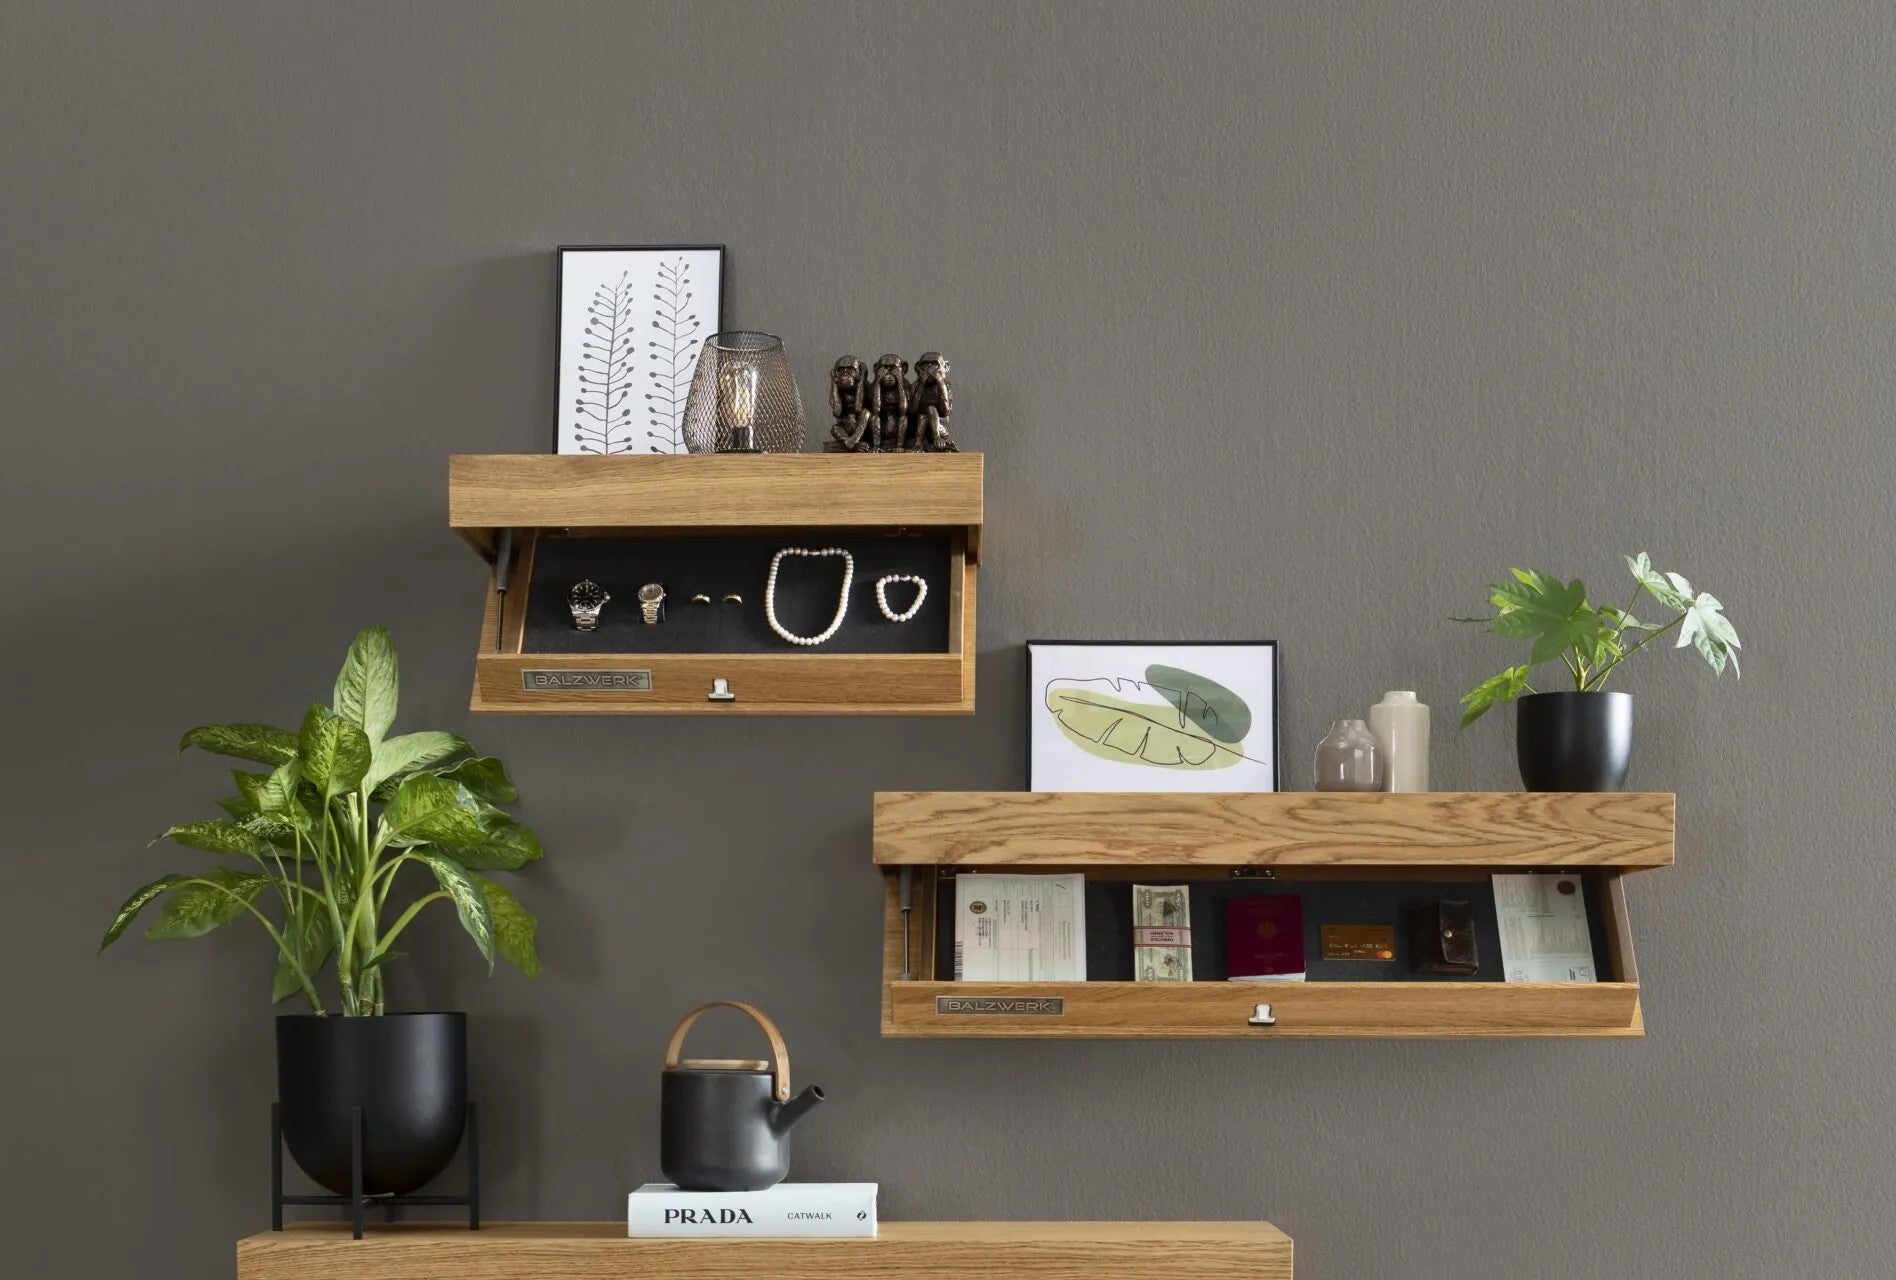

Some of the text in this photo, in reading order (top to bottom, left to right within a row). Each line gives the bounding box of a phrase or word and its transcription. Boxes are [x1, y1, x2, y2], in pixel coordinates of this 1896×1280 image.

[948, 1001, 1052, 1011] BALZWERK
[664, 1208, 832, 1224] PRADA CATWALK
